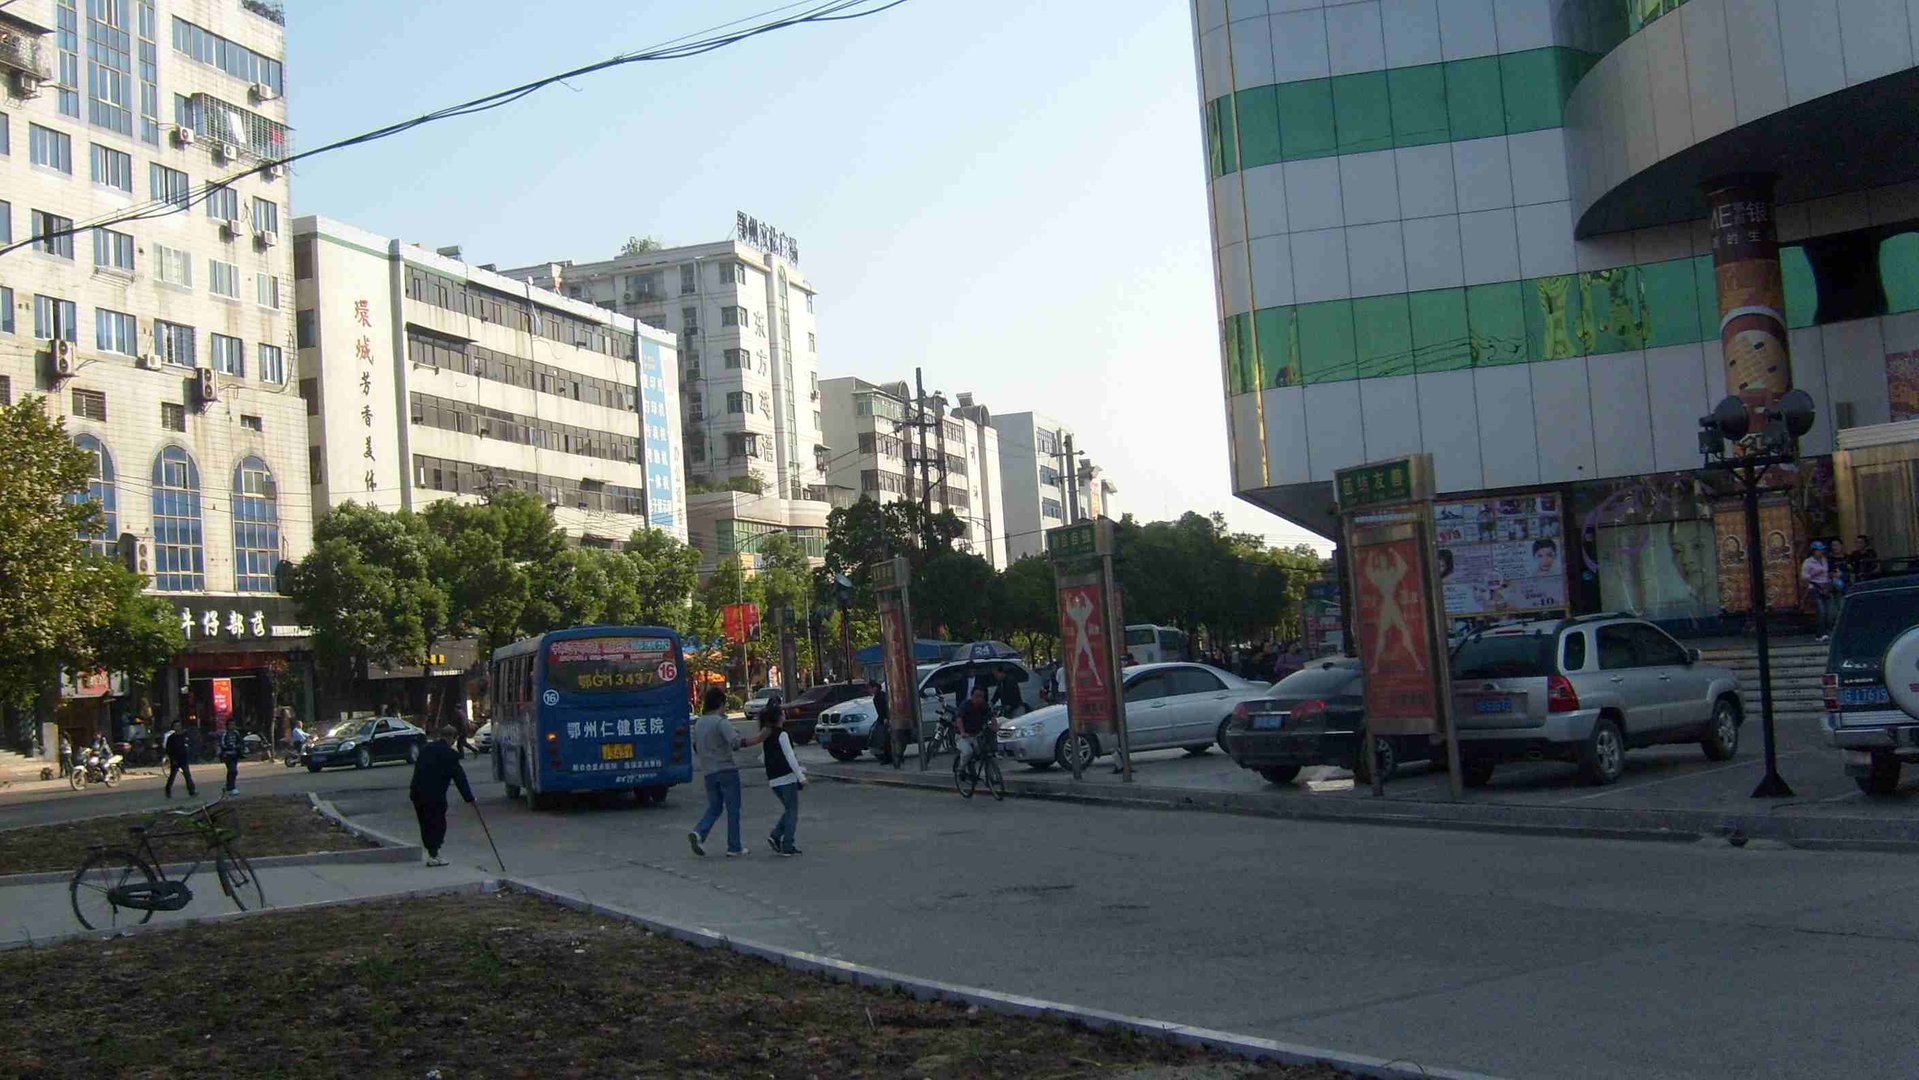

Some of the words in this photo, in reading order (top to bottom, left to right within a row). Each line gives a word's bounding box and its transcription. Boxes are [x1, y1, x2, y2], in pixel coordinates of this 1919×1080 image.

[737, 209, 799, 266] 鄂州文化广场
[180, 607, 265, 640] 牛仔部落
[660, 663, 675, 680] 16
[567, 717, 665, 739] 鄂州仁健医院
